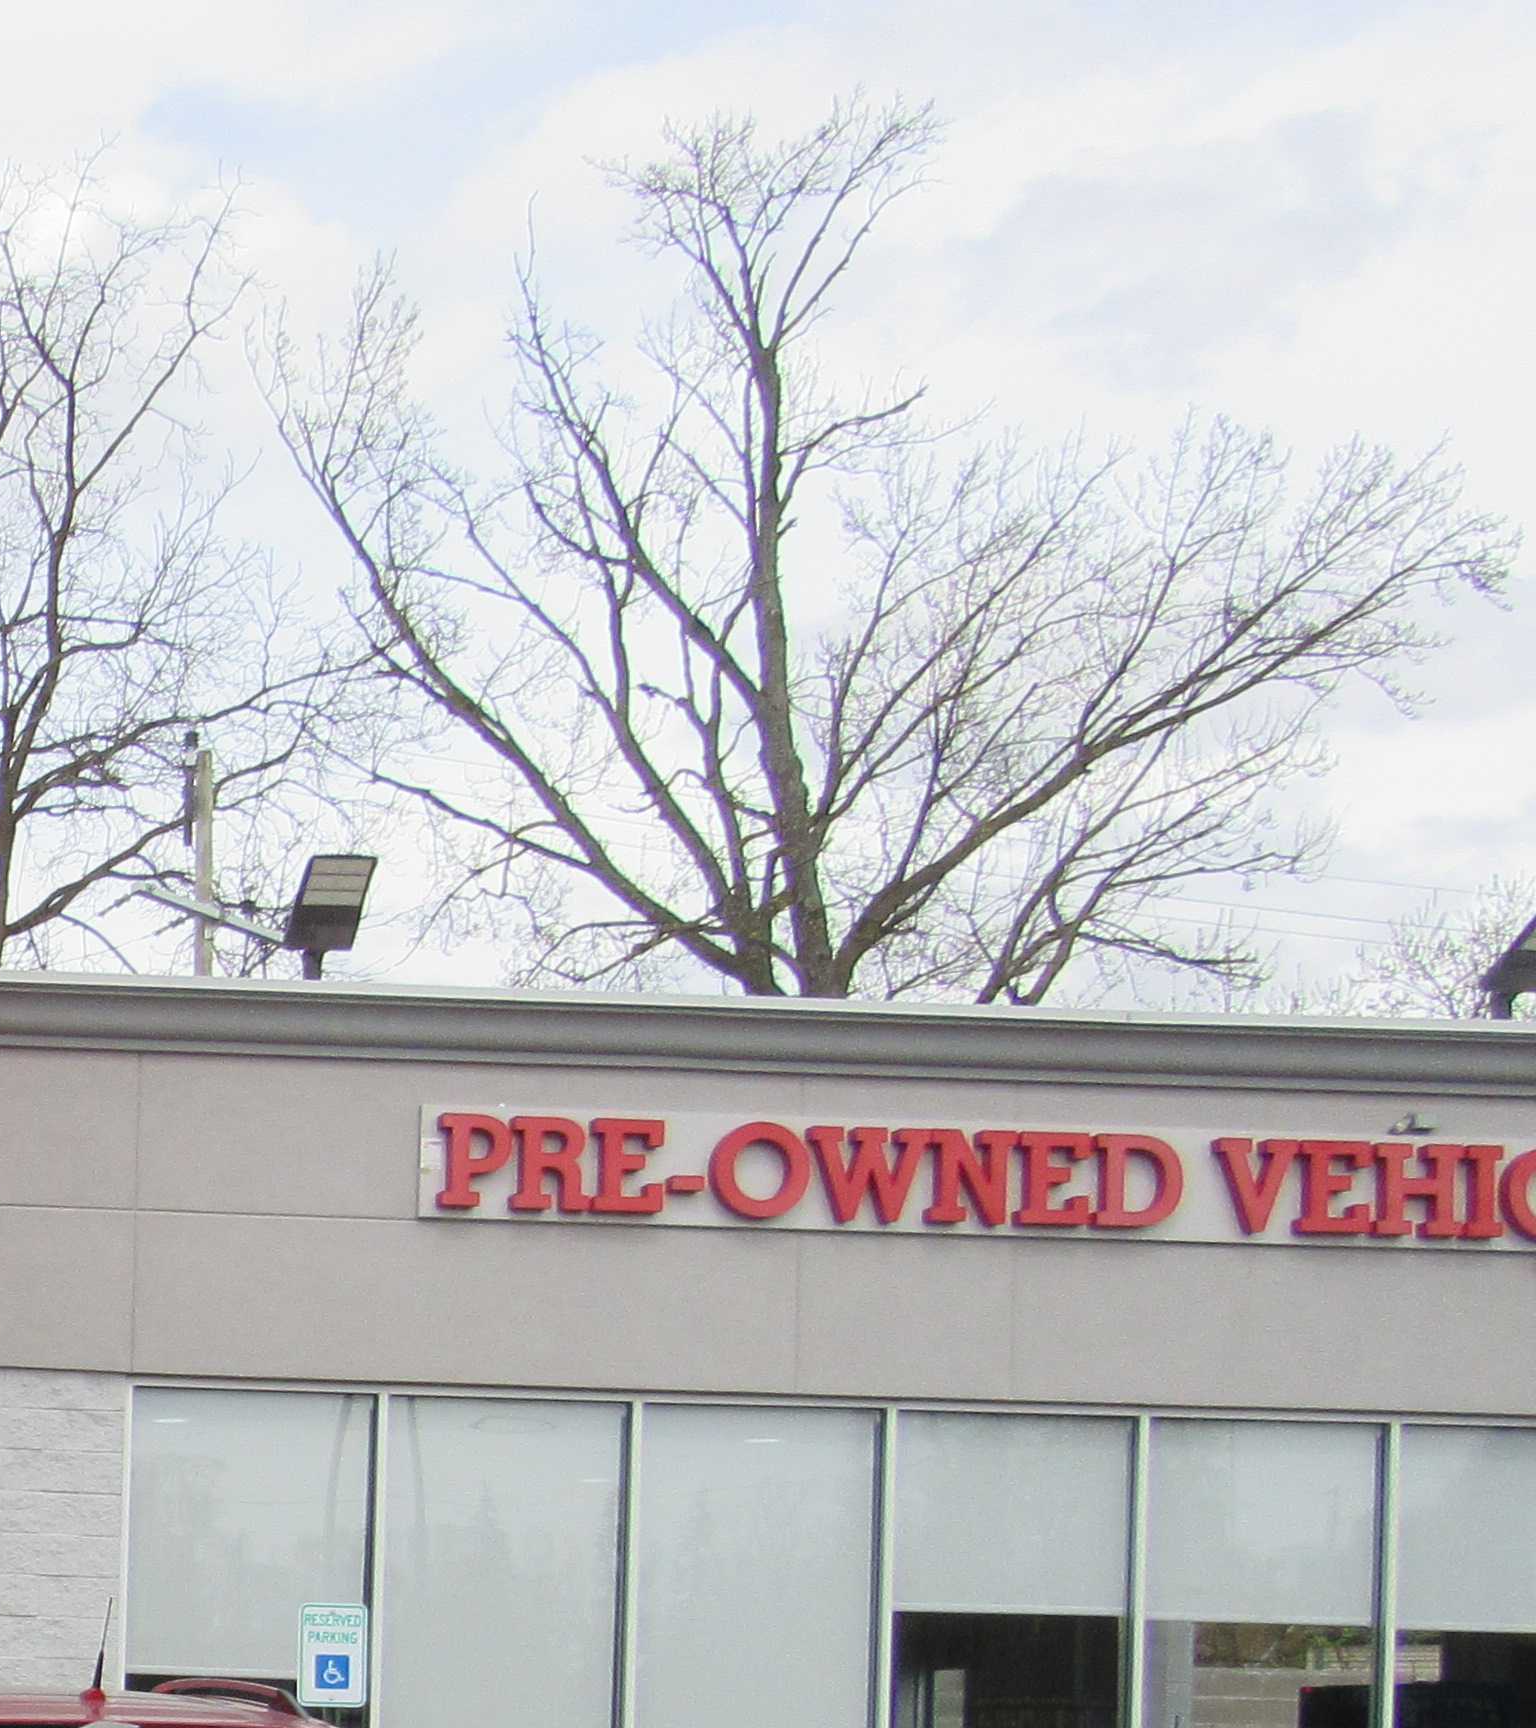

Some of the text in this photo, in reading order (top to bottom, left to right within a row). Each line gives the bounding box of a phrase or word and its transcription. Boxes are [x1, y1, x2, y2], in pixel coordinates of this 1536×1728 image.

[436, 1112, 1185, 1229] PRE-OWNED
[304, 1613, 362, 1628] RESERVED
[307, 1631, 359, 1644] PARKING
